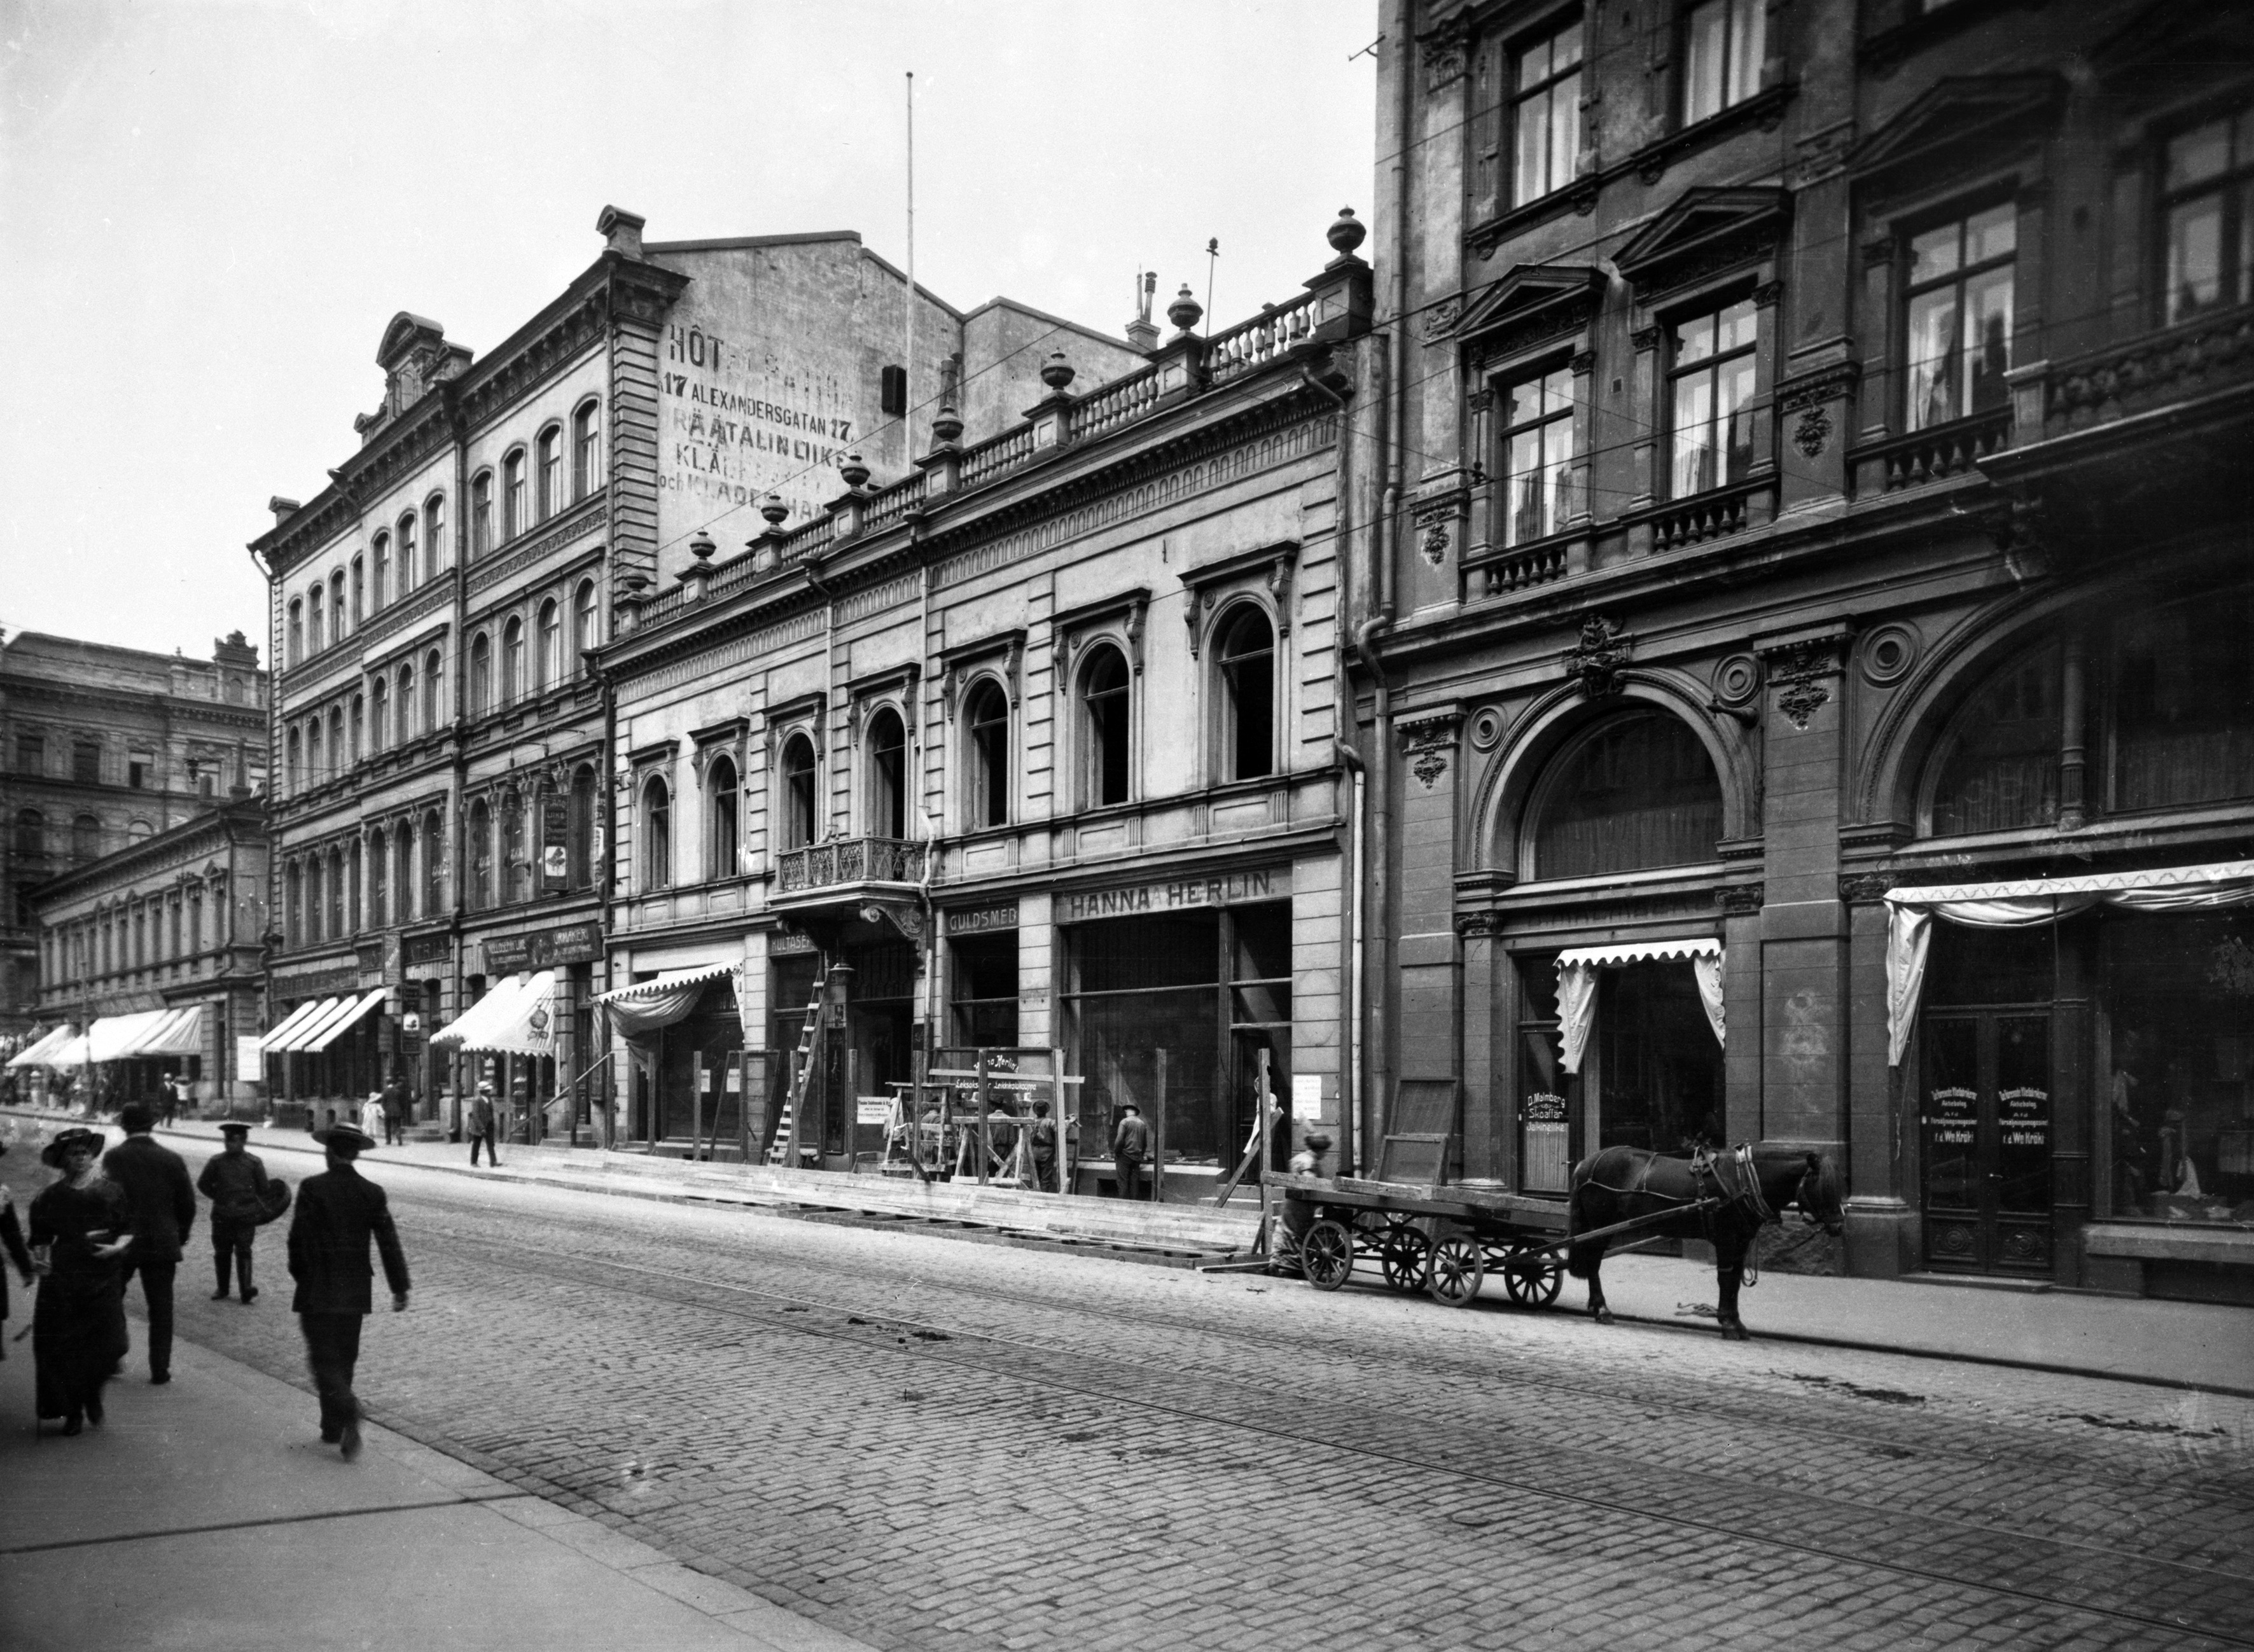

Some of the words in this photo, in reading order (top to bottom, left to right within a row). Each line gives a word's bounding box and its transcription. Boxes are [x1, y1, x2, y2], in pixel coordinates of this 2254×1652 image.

[664, 371, 688, 398] 17
[691, 383, 826, 436] ALEXANDERSGATAN
[1071, 887, 1151, 918] HANNA
[949, 908, 1017, 931] GULDSMED
[1941, 1099, 1967, 1108] Aktiebolag
[2009, 1100, 2038, 1109] Aktiebolag
[1528, 1107, 1562, 1118] Skoaffär
